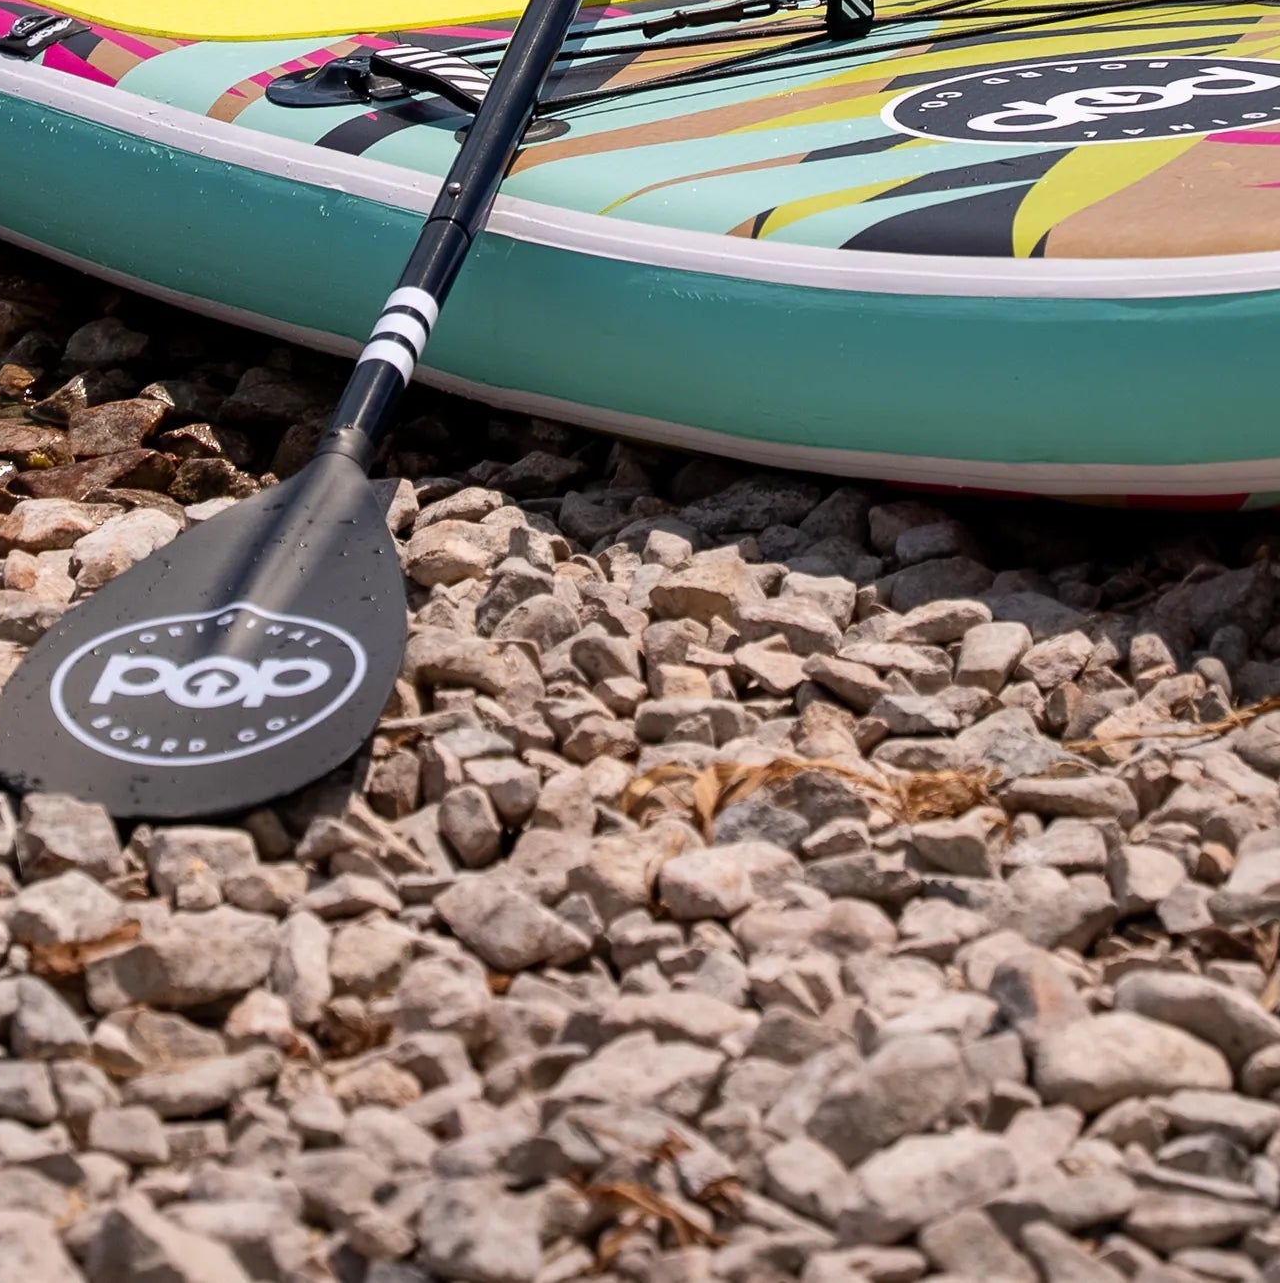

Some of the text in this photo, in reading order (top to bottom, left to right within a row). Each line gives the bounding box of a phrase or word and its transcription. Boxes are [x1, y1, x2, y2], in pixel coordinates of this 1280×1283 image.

[982, 61, 1169, 85] BOARD
[88, 653, 333, 709] pop
[90, 715, 208, 754] BOARD
